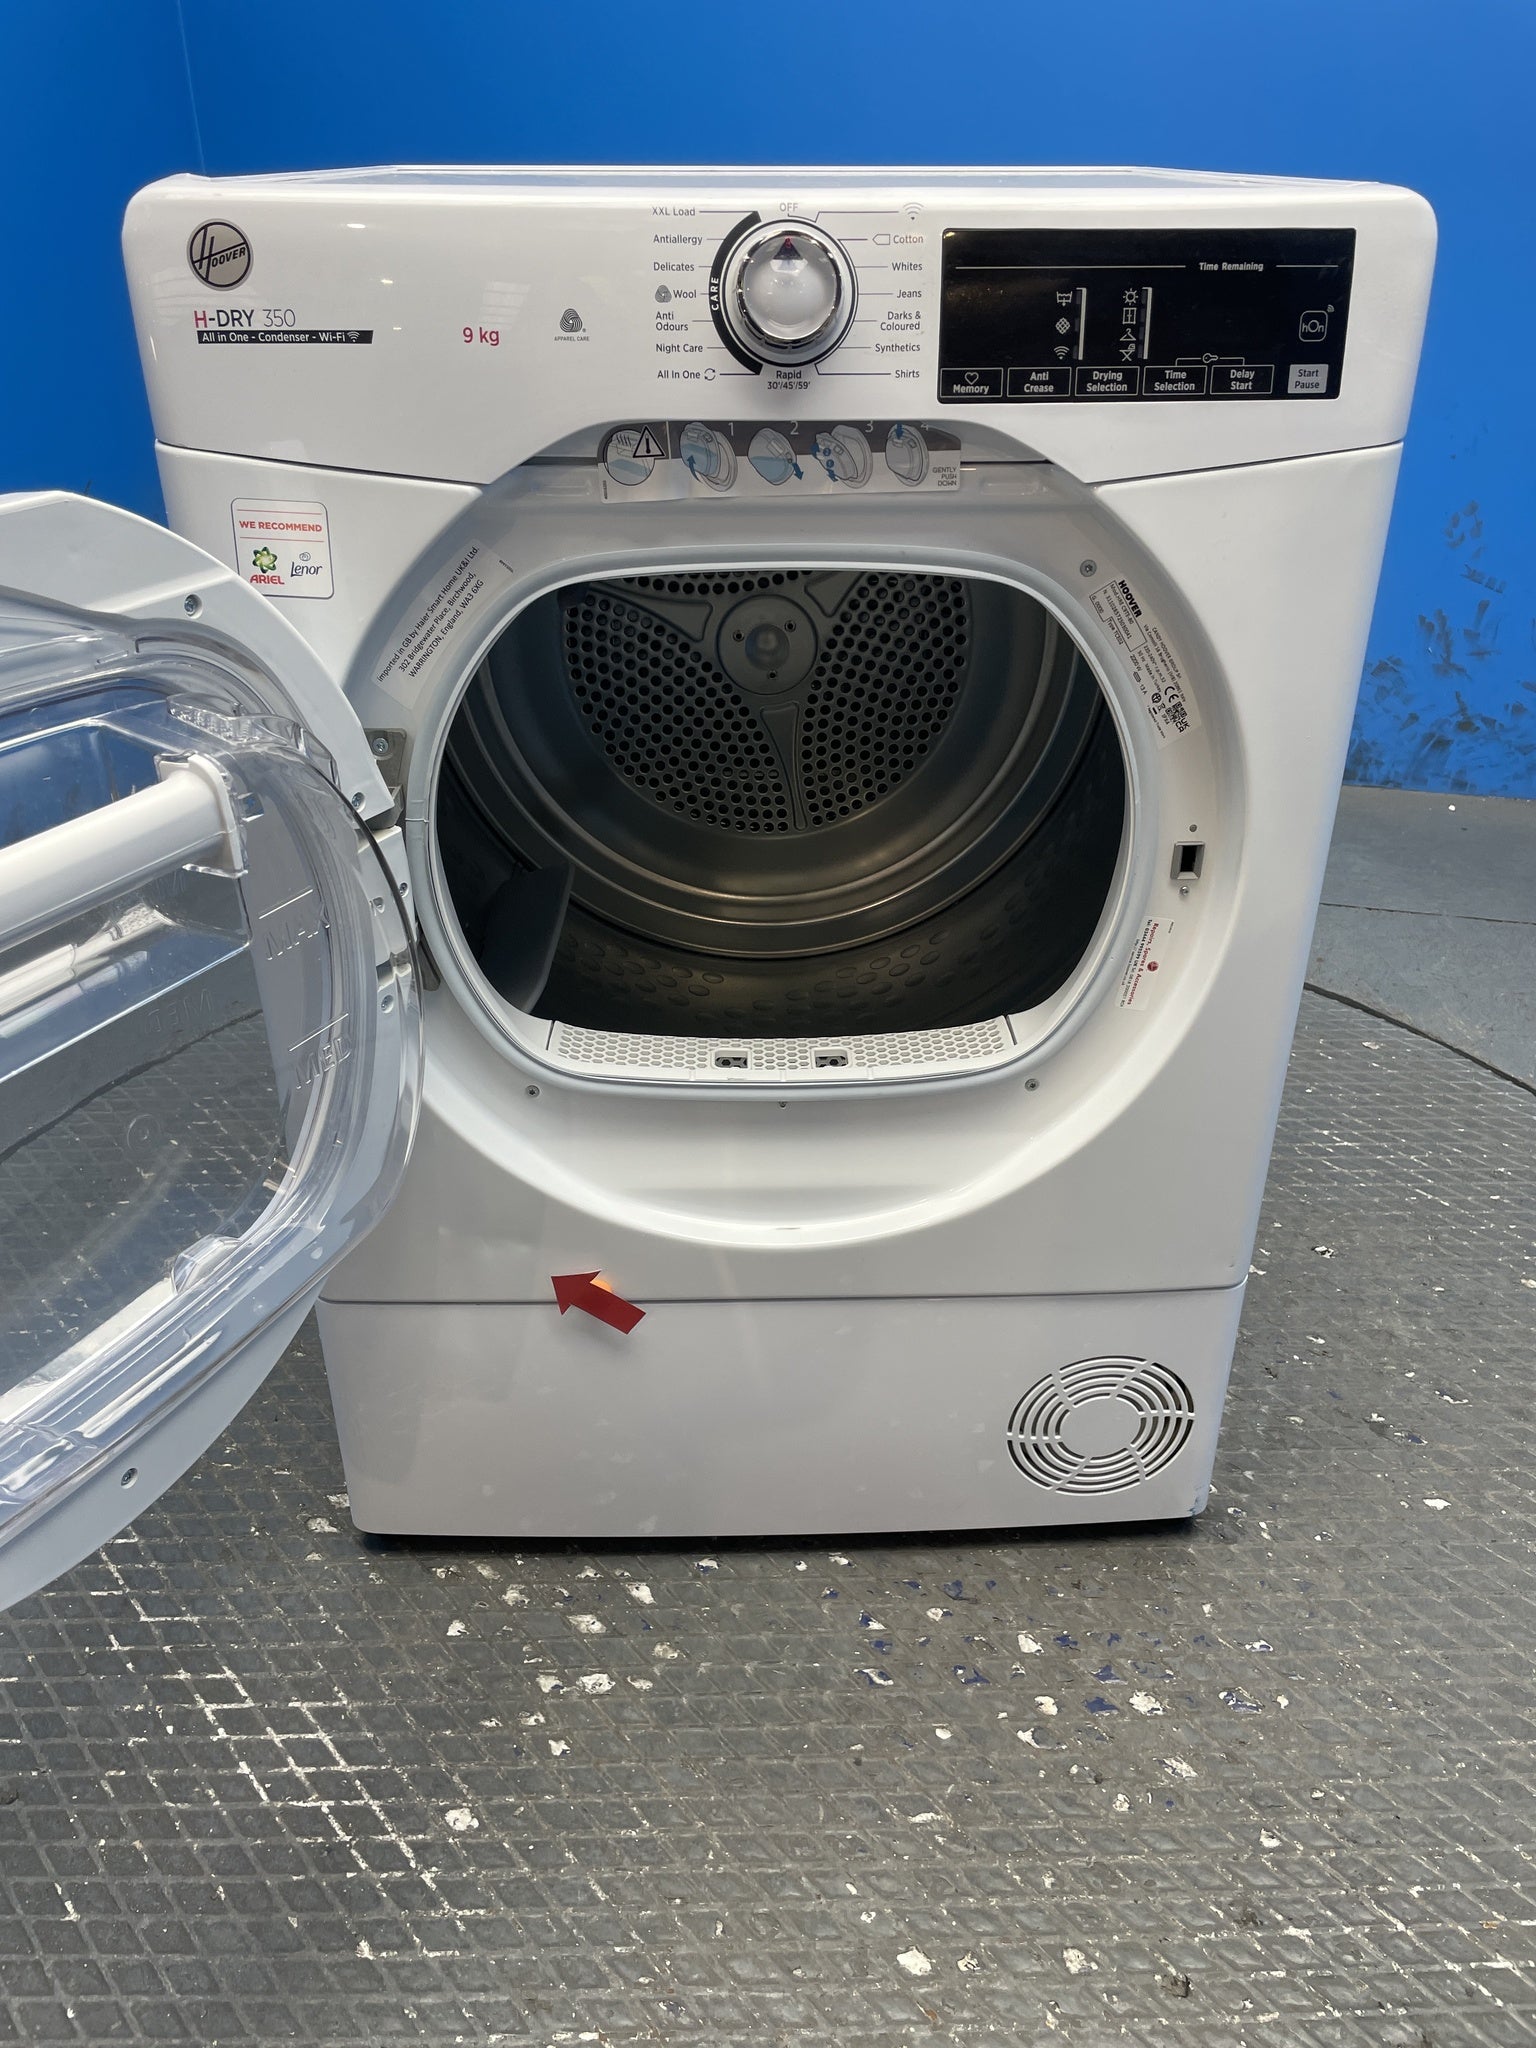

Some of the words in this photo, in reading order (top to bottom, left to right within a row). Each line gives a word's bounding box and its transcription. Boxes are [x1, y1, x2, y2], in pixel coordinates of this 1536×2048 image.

[652, 207, 670, 216] XXL
[673, 207, 696, 216] Load
[779, 203, 798, 213] OFF
[653, 234, 702, 245] Antiallergy
[893, 235, 924, 244] Cotton
[653, 262, 694, 271] Delicates
[891, 262, 923, 271] Whites
[1199, 262, 1219, 271] Time
[1222, 262, 1264, 272] Remaining
[673, 289, 697, 299] Wool
[711, 277, 719, 311] CARE
[896, 290, 922, 298] Jeans
[194, 309, 255, 328] H-DRY
[262, 309, 296, 327] 350
[656, 311, 674, 320] Anti
[887, 311, 913, 320] Darks
[915, 310, 921, 320] &
[656, 322, 688, 331] Odours
[880, 321, 921, 331] Coloured
[202, 333, 215, 342] All
[218, 333, 226, 342] in
[229, 333, 249, 342] One
[258, 333, 309, 342] Condenser
[319, 333, 346, 342] Wi-Fi
[463, 327, 473, 343] 9
[479, 327, 500, 346] kg
[656, 343, 681, 354] Night
[683, 343, 703, 353] Care
[875, 343, 921, 354] Synthetics
[657, 370, 669, 379] All
[672, 370, 680, 379] In
[682, 370, 701, 379] One
[776, 370, 802, 380] Rapid
[895, 369, 920, 379] Shirts
[1030, 371, 1049, 381] Anti
[1092, 371, 1123, 382] Drying
[1165, 369, 1187, 379] Time
[1230, 369, 1255, 380] Delay
[1297, 369, 1320, 378] Start
[953, 384, 990, 394] Memory
[1023, 384, 1054, 393] Crease
[1086, 382, 1128, 392] Selection
[1154, 381, 1196, 391] Selection
[1230, 380, 1253, 390] Start
[1294, 380, 1320, 389] Pause
[727, 422, 735, 437] 1
[789, 420, 799, 435] 2
[864, 420, 874, 433] 3
[239, 520, 256, 529] WE
[258, 521, 323, 532] RECOMMEND
[290, 561, 323, 578] Lenor
[250, 574, 285, 585] ARIEL
[398, 647, 406, 656] in
[402, 636, 412, 647] GB
[410, 629, 419, 640] by
[416, 613, 430, 631] Haier
[427, 592, 443, 613] Smart
[441, 576, 458, 596] Home
[455, 557, 470, 576] UK&I
[468, 546, 480, 559] Ltd.
[1118, 579, 1143, 618] HOOVER
[399, 659, 410, 672] 302
[408, 623, 440, 661] Bridgewater
[434, 607, 451, 628] Place,
[448, 572, 476, 607] Birchwood,
[408, 635, 444, 678] WARRINGTON,
[440, 609, 463, 635] England,
[459, 593, 474, 610] WA3
[473, 579, 484, 594] 6XG
[1180, 717, 1190, 729] UK
[1146, 922, 1159, 946] Repairs,
[1140, 947, 1151, 966] Spares
[1127, 973, 1142, 1005] Accessories
[297, 1038, 351, 1089] MED
